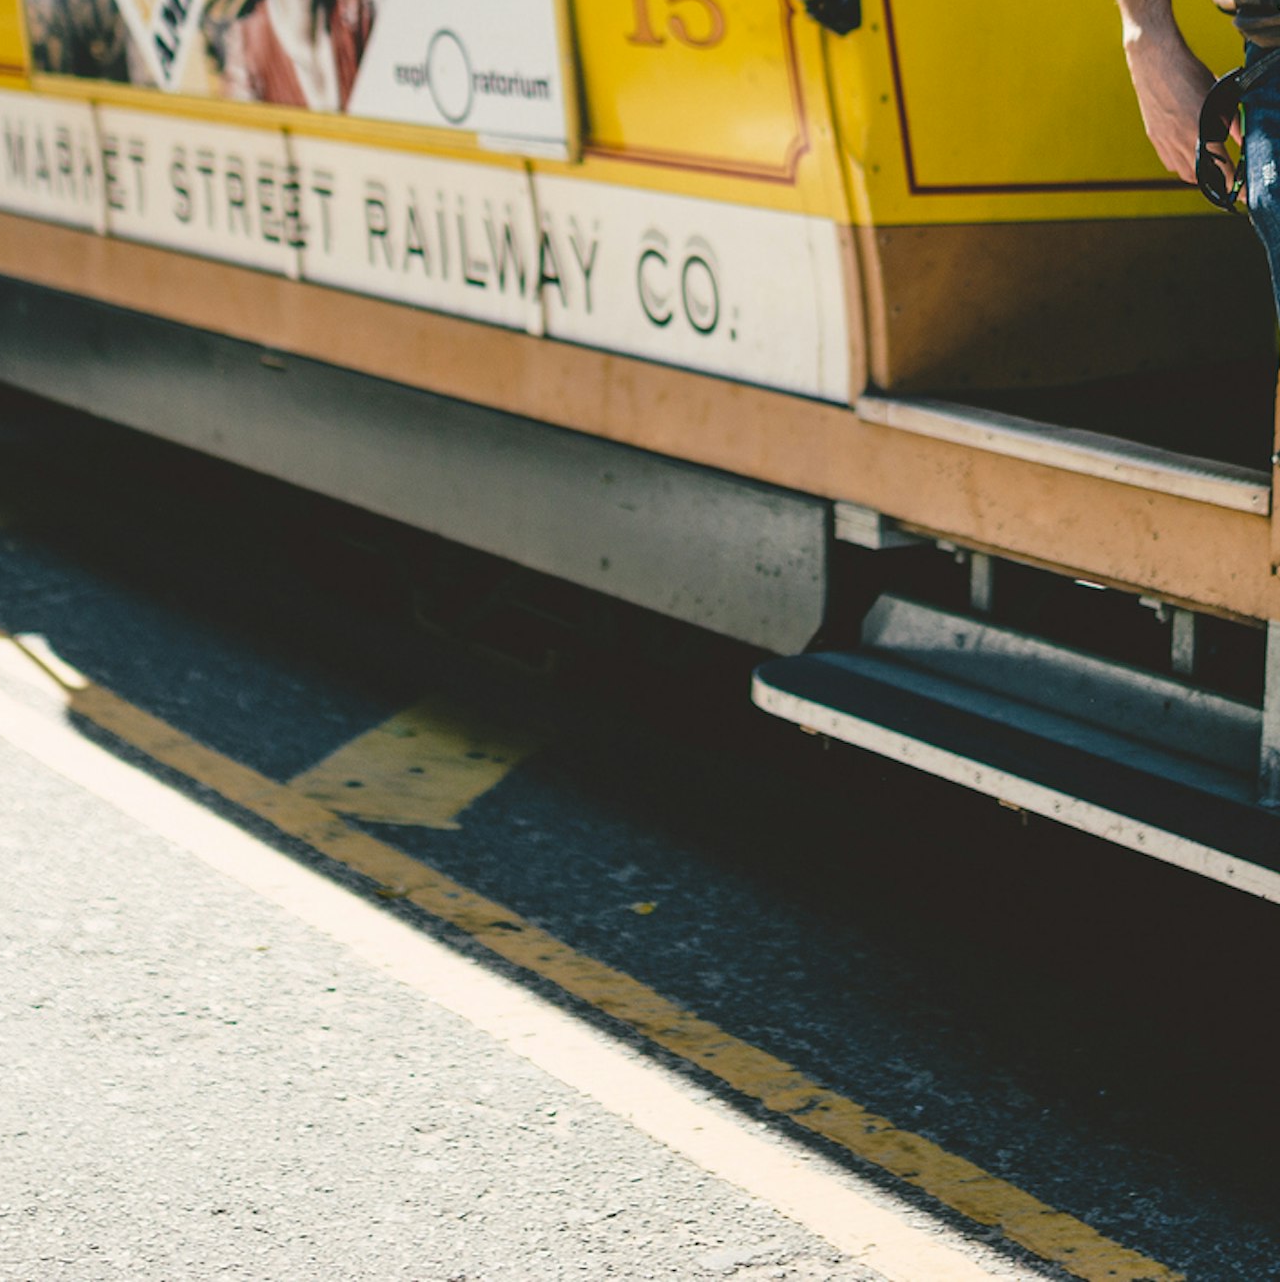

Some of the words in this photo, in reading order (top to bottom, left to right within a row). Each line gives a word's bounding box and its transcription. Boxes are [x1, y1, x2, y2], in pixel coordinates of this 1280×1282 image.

[170, 143, 343, 255] STREET
[365, 180, 602, 315] RAILWAY
[637, 226, 741, 341] CO.
